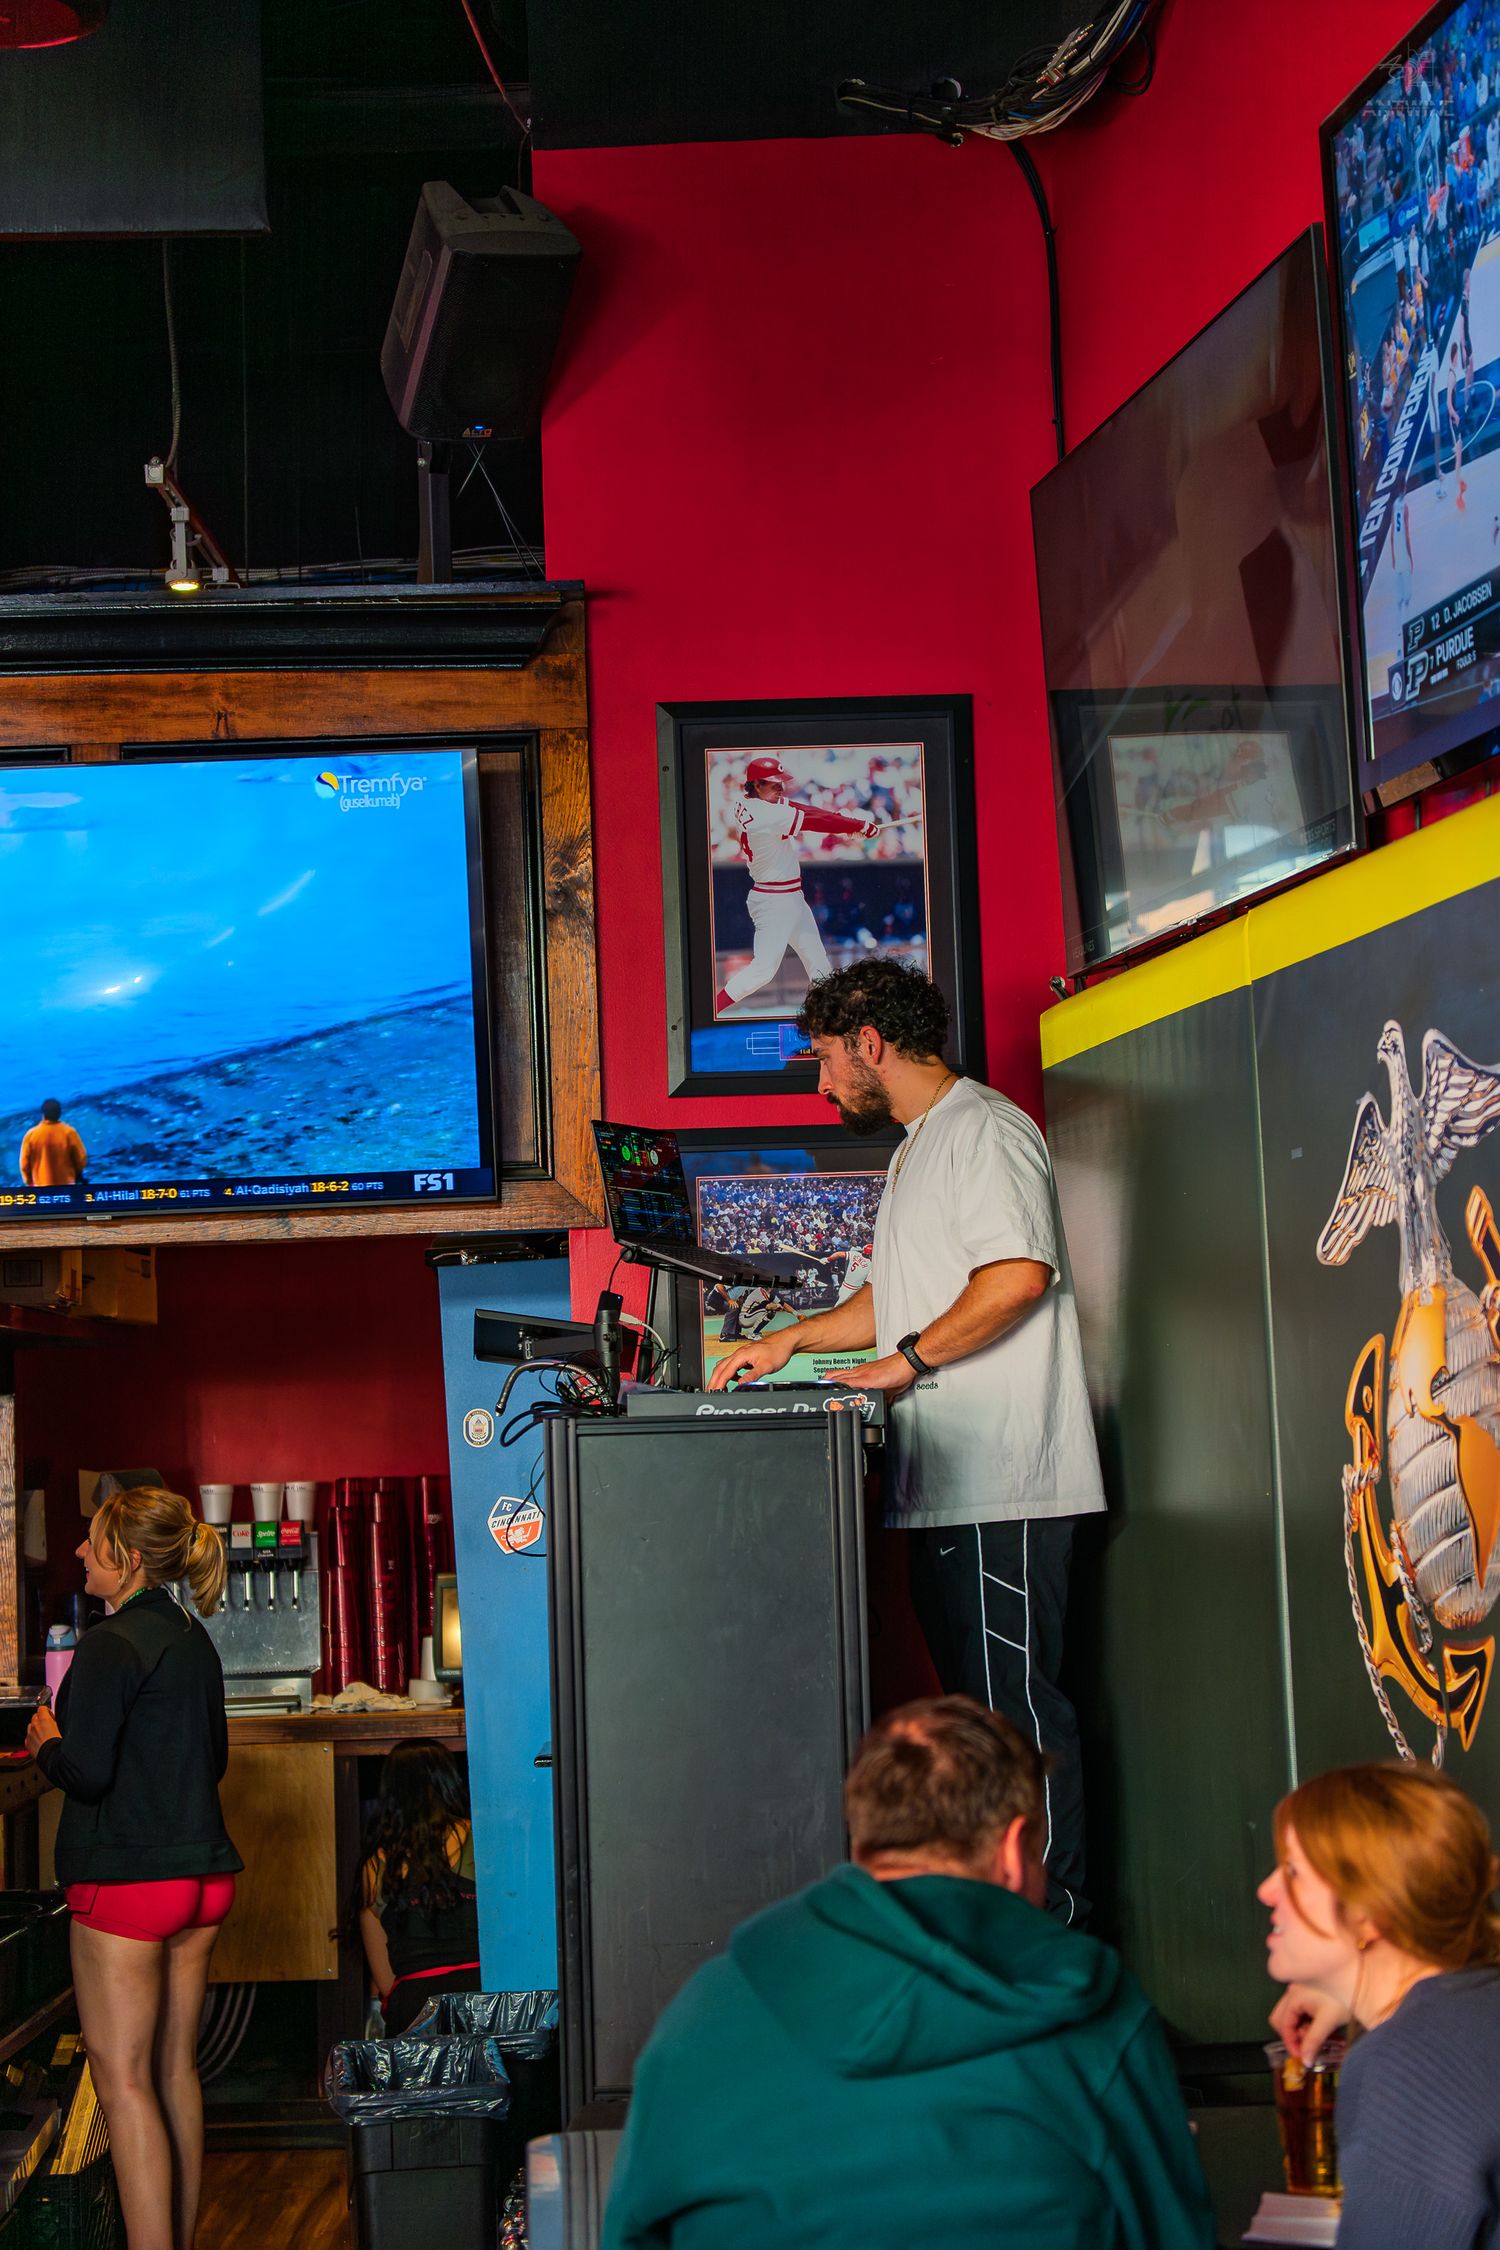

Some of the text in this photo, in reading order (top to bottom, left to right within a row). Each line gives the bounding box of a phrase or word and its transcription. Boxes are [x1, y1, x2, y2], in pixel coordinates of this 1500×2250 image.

[1360, 492, 1391, 550] TEN
[1431, 612, 1441, 631] 12
[1443, 606, 1453, 623] D.
[1453, 581, 1493, 618] JACOBSEN
[1435, 625, 1474, 667] PURDUE
[337, 772, 424, 797] Tremfya
[53, 1194, 72, 1204] PTS
[84, 1193, 95, 1203] 3.
[96, 1189, 140, 1202] Al-Hilal
[141, 1187, 178, 1200] 18-7-0
[192, 1188, 210, 1199] PTS
[223, 1187, 235, 1196] 4.
[236, 1184, 309, 1197] Al-Qadisiyah
[311, 1180, 350, 1193] 18-6-2
[366, 1181, 385, 1191] PTS
[413, 1172, 455, 1192] FS1
[850, 1261, 859, 1272] 5
[812, 1356, 867, 1366] Johnny Bench Night
[916, 1381, 939, 1391] seeds
[502, 1501, 513, 1512] FC
[491, 1511, 540, 1529] CINCNNATI
[256, 1529, 276, 1539] Sprite
